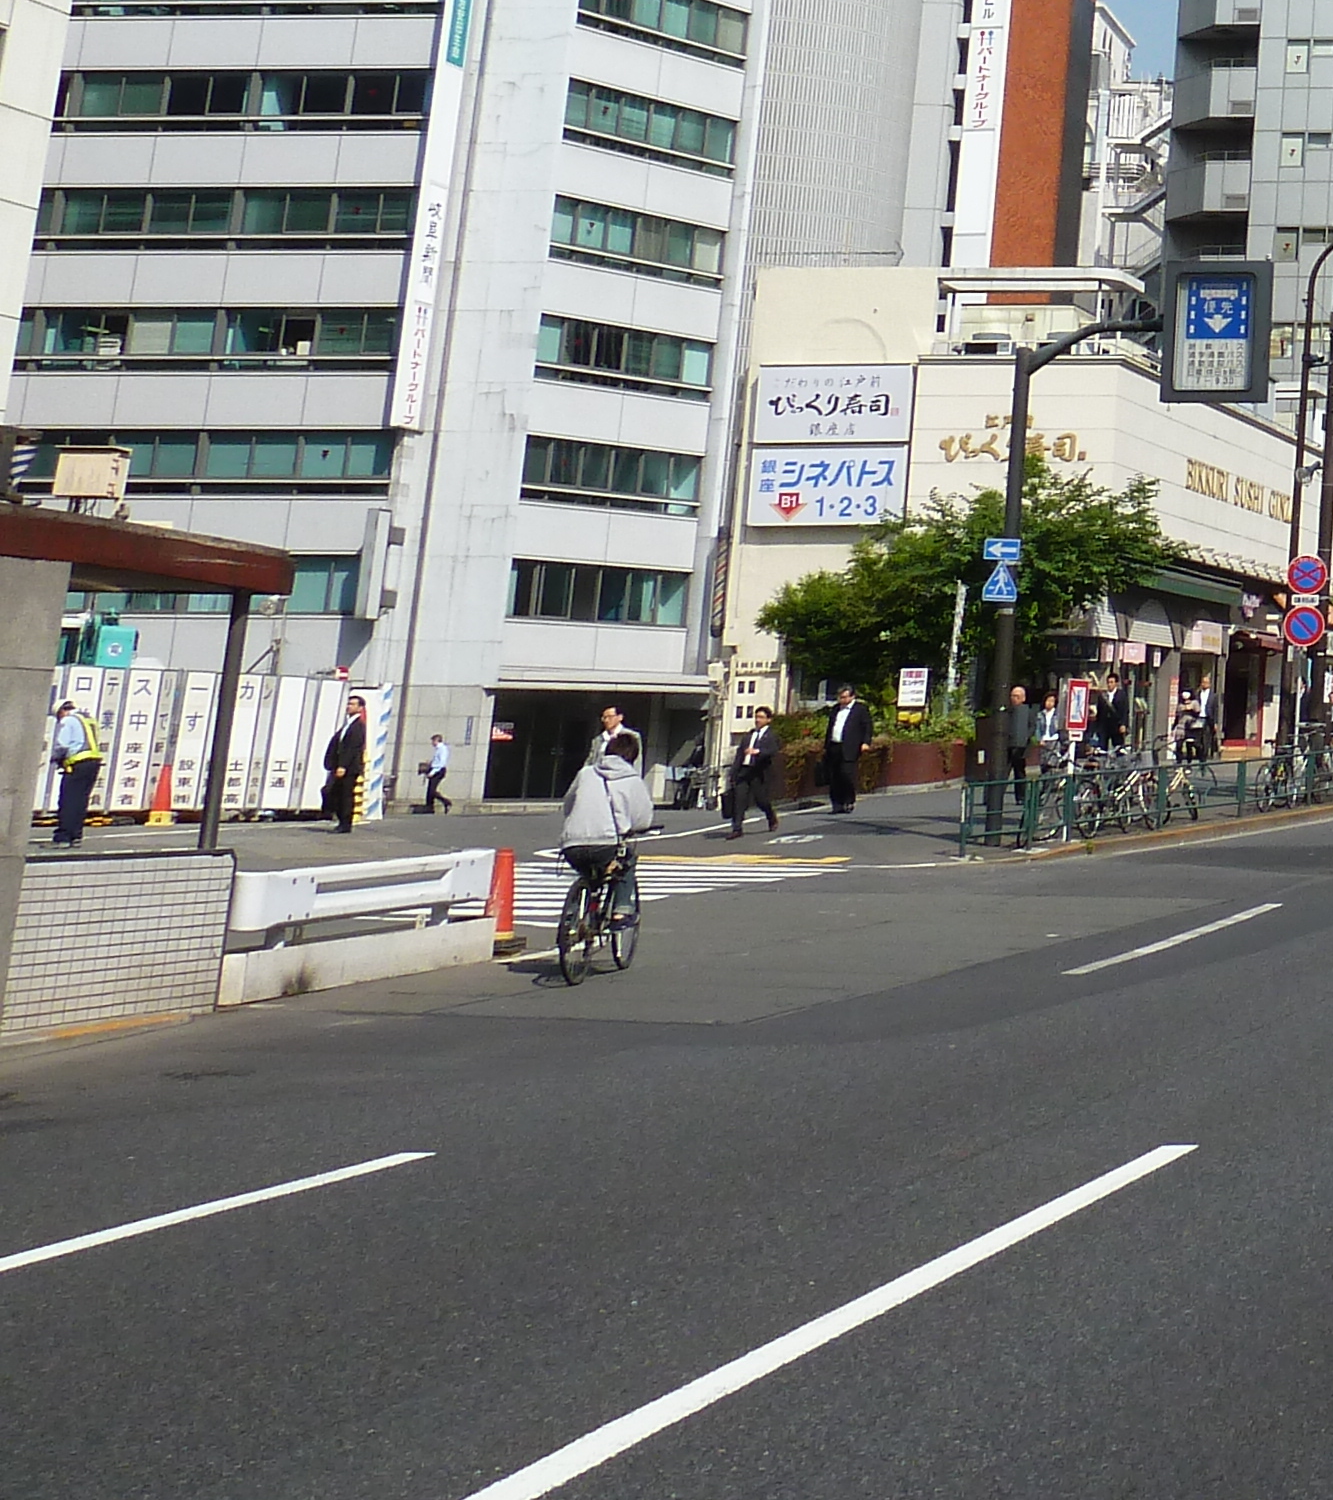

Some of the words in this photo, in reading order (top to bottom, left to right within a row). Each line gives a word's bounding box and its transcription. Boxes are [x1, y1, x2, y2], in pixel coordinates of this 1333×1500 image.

[972, 47, 994, 129] パートナーグループ
[1203, 300, 1234, 314] 優先
[402, 328, 427, 426] パートナーグループ
[768, 392, 891, 417] びっくり寿司
[808, 422, 857, 437] 銀座店
[758, 459, 777, 493] 銀座
[778, 459, 896, 488] シネパトス
[1185, 458, 1230, 502] BIKKURI
[1233, 475, 1265, 516] SUSHI
[781, 495, 797, 508] B1
